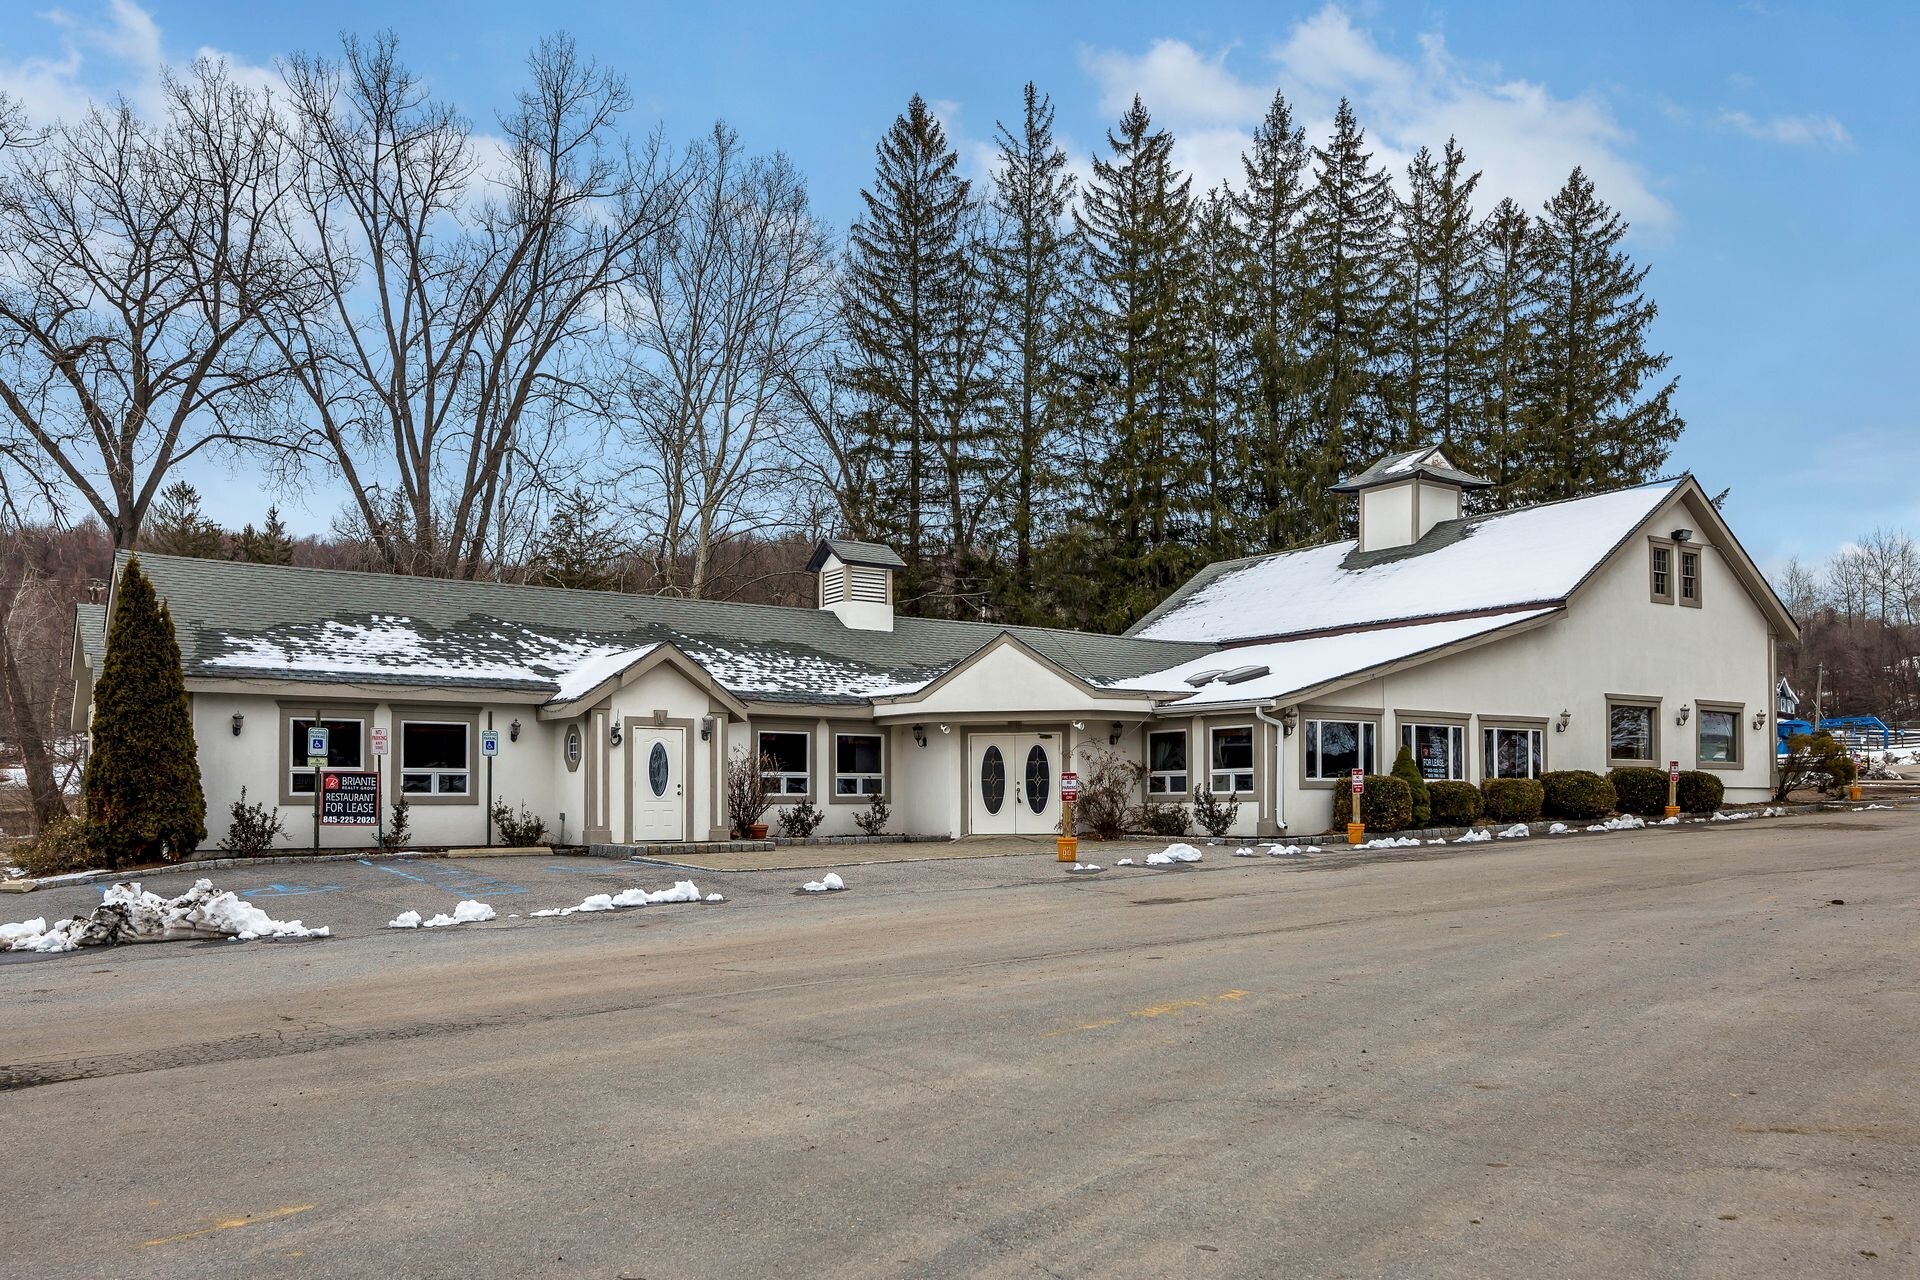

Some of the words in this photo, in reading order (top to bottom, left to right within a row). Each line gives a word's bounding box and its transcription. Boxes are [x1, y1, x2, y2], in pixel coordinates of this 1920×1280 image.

[341, 776, 377, 786] BRIANTE
[325, 792, 375, 802] RESTAURANT
[325, 802, 344, 813] FOR
[346, 802, 374, 813] LEASE
[322, 815, 376, 824] 845-225-2020
